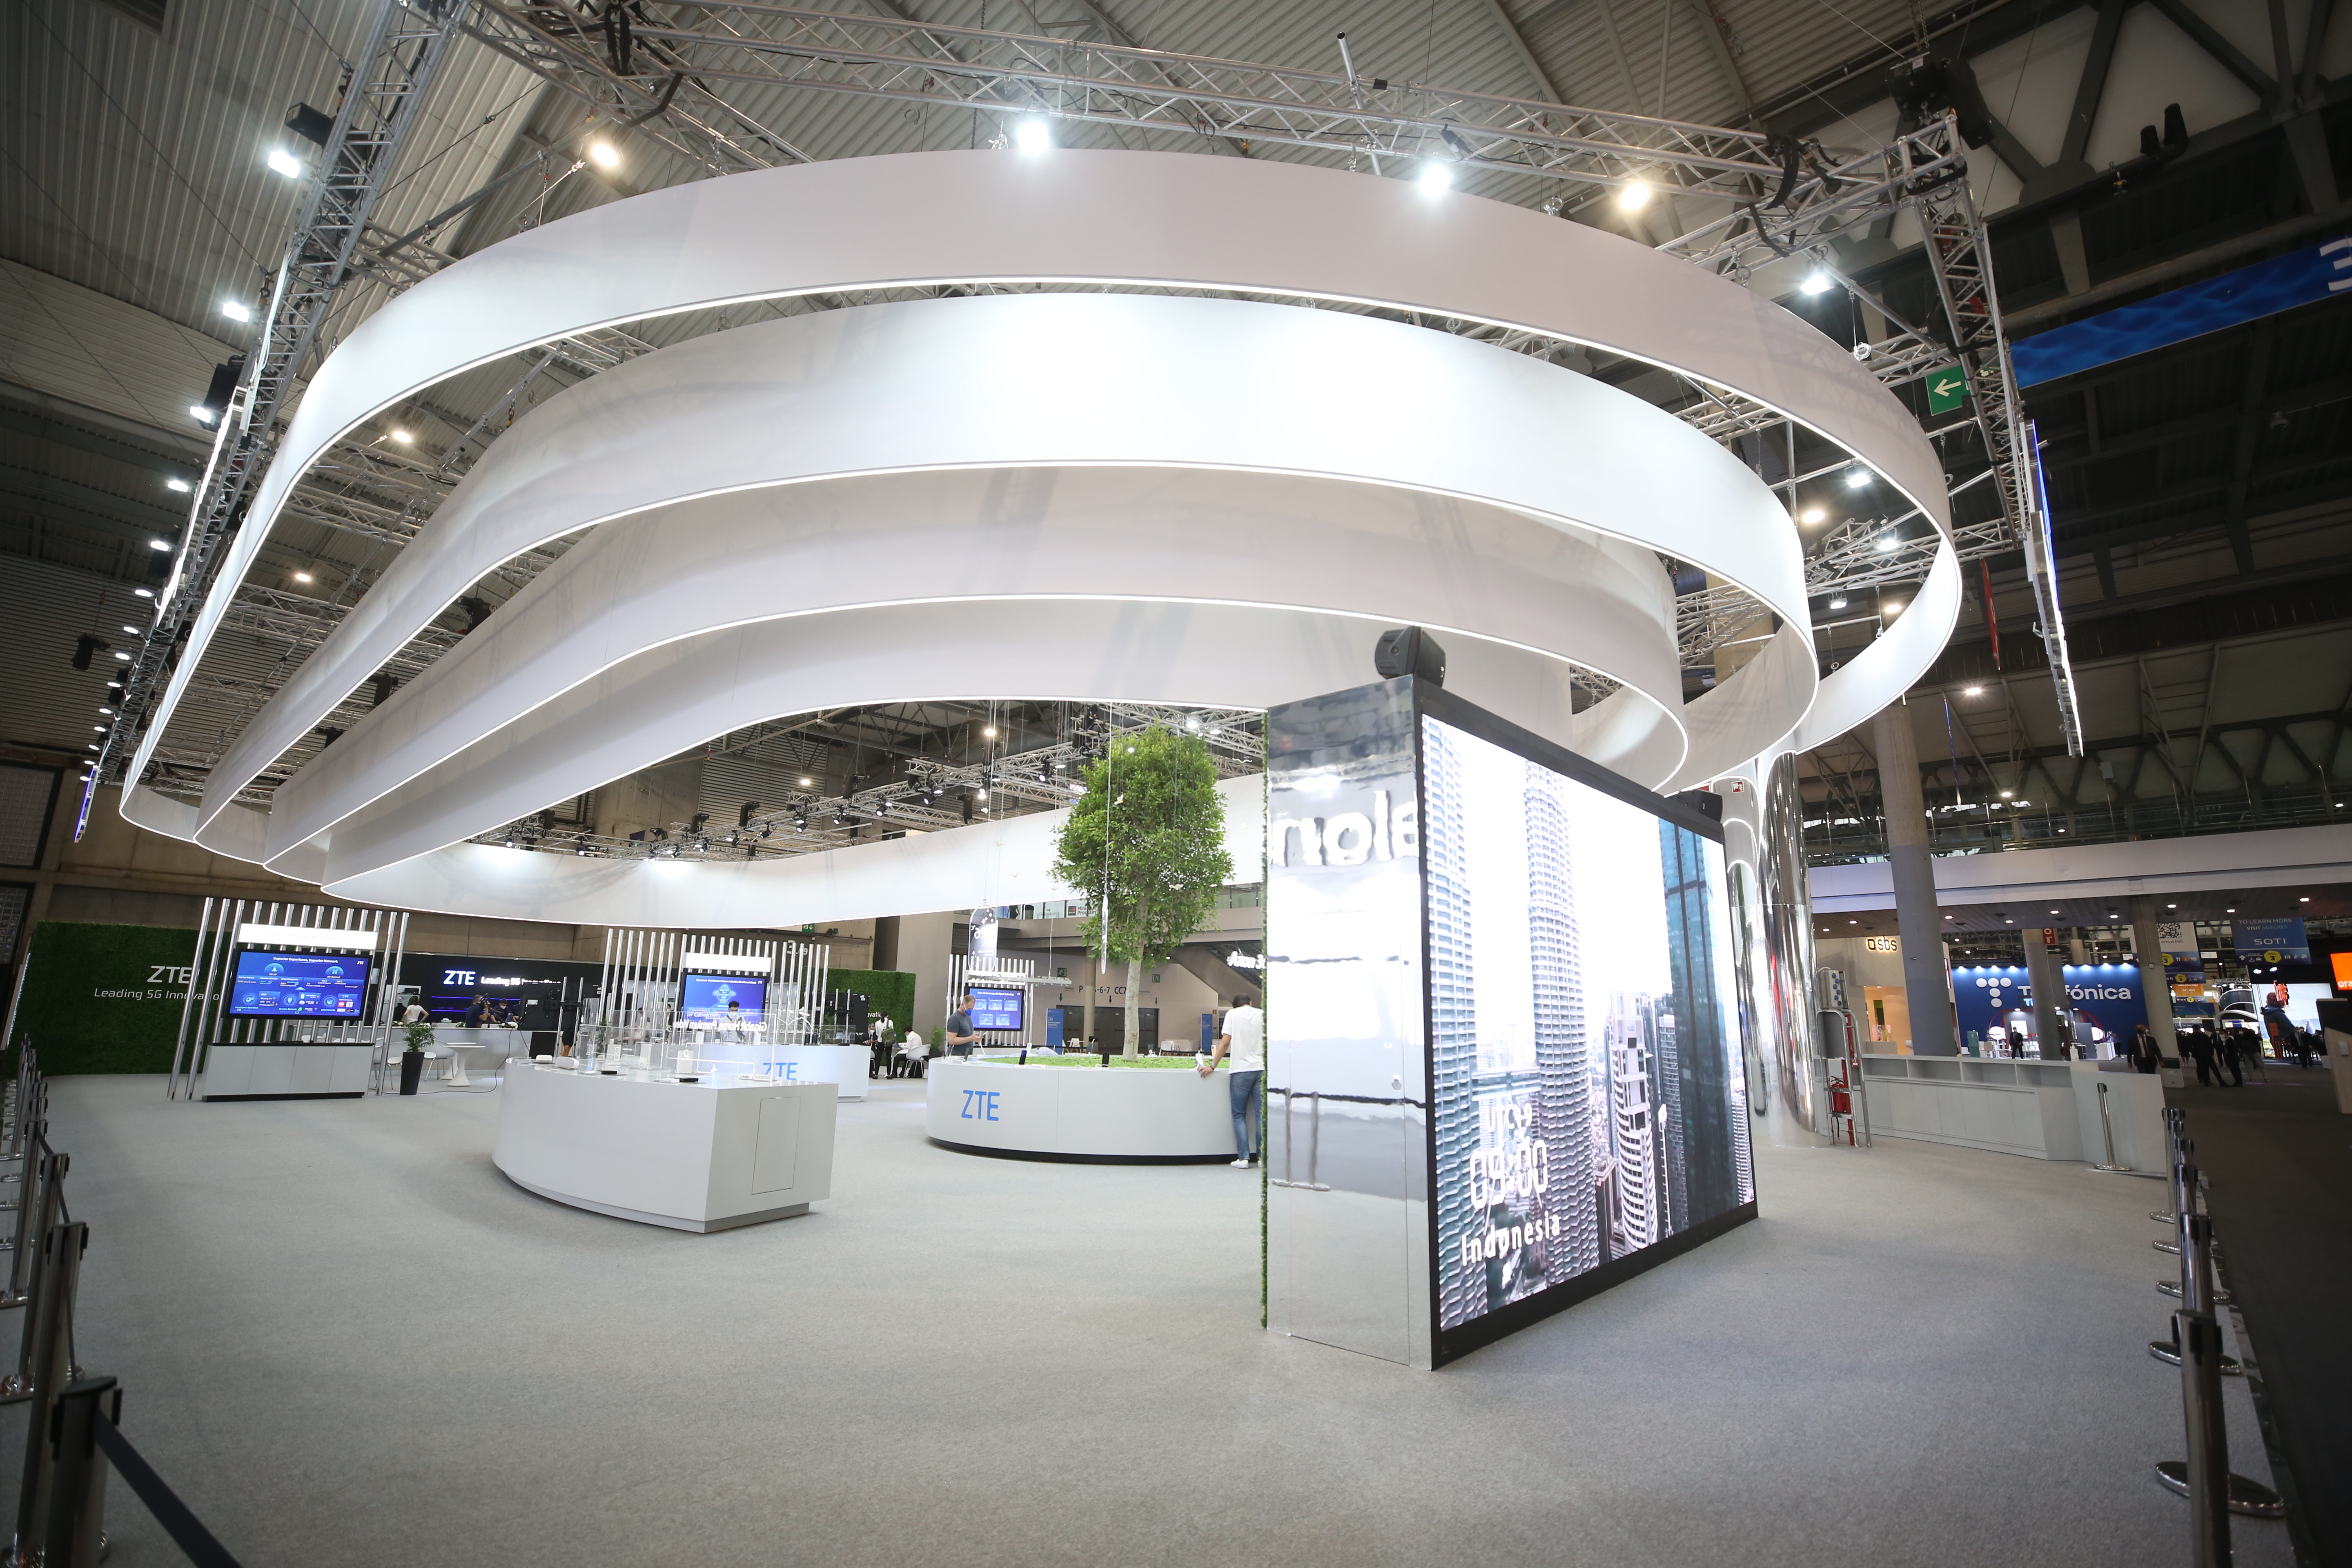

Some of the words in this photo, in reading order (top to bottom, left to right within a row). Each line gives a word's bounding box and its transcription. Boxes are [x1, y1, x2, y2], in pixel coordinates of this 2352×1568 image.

[787, 940, 808, 955] 3.9
[1877, 936, 1897, 951] sbs
[443, 971, 476, 985] ZTE
[481, 976, 509, 986] Leading
[94, 988, 143, 1000] Leading
[147, 990, 162, 998] 5G
[762, 1062, 798, 1080] ZTE
[961, 1090, 1000, 1121] ZTE
[1486, 1102, 1532, 1132] UTC+9
[1470, 1139, 1548, 1209] 09:00
[1461, 1210, 1560, 1266] Indonesia
